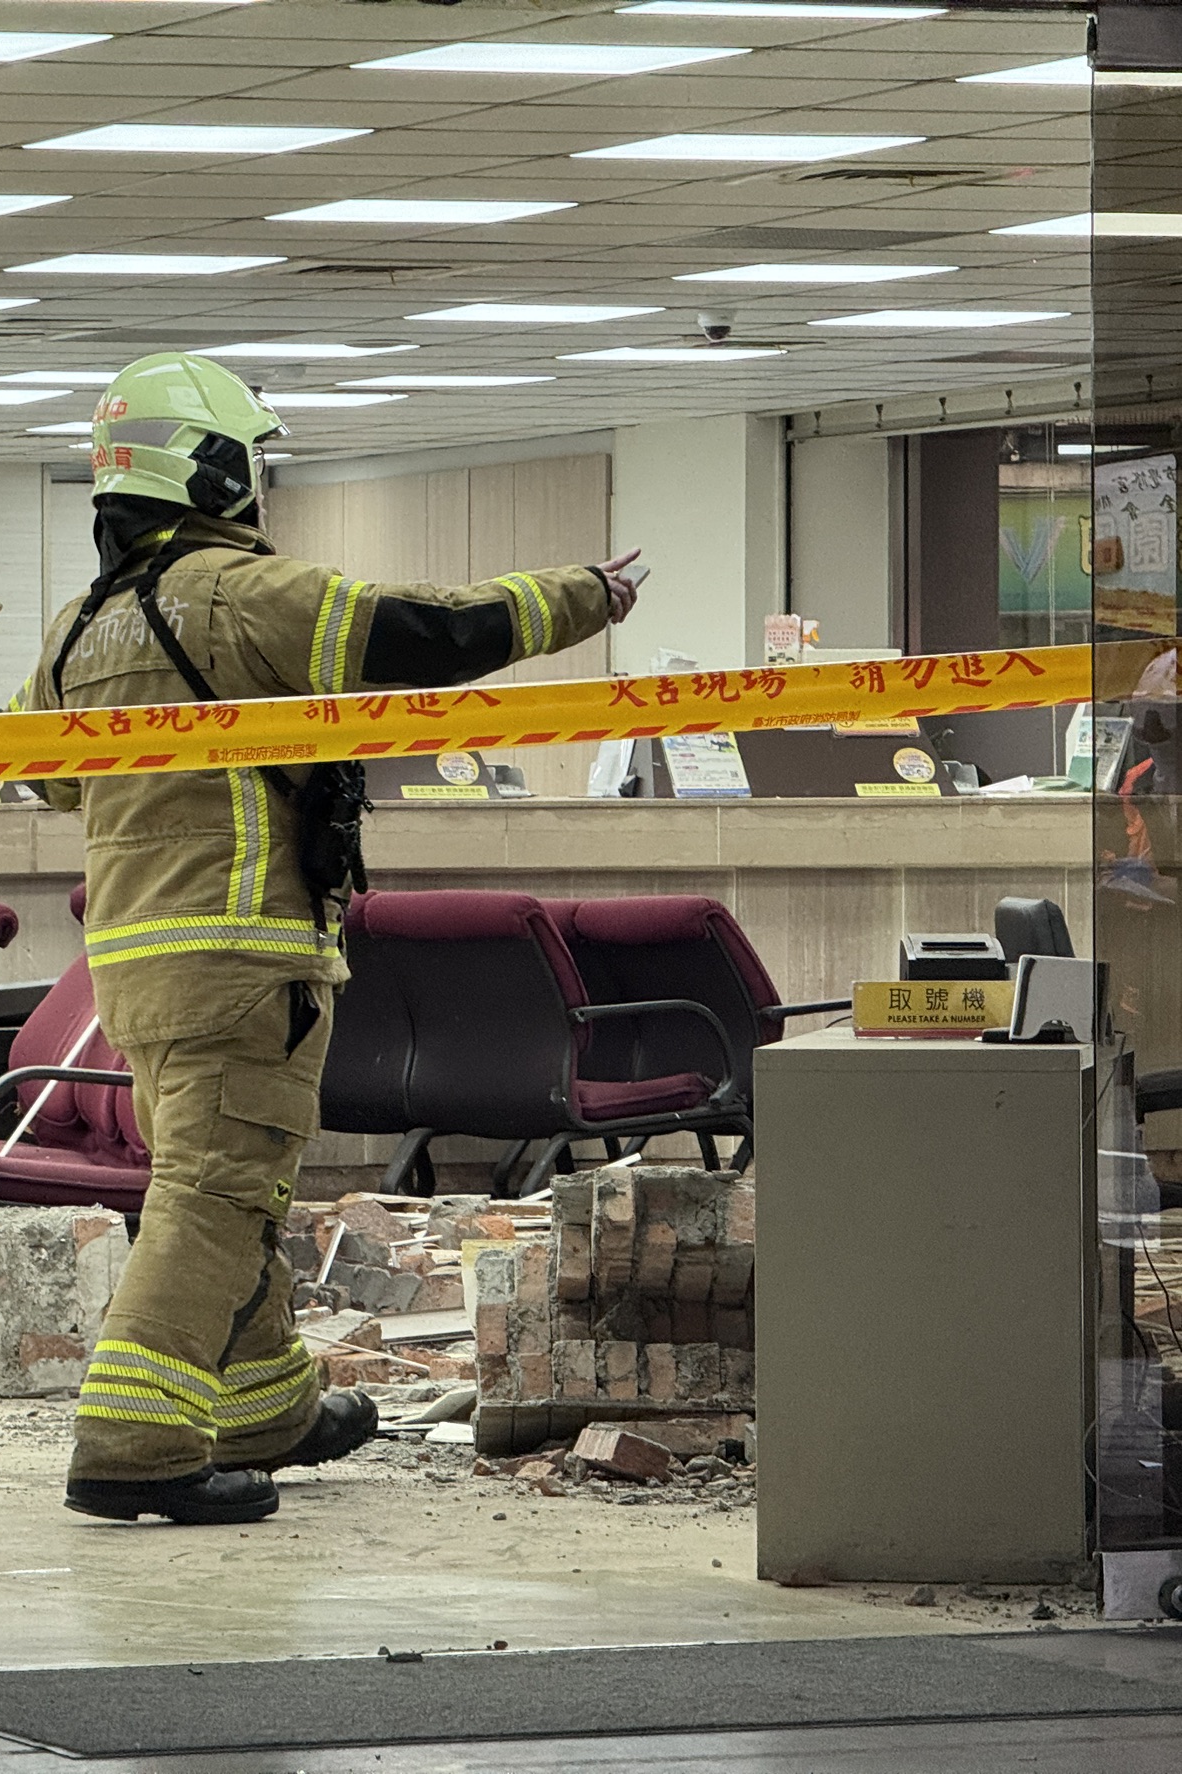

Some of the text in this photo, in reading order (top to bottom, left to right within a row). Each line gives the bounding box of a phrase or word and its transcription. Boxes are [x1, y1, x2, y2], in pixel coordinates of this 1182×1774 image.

[888, 987, 986, 1011] 取號機
[887, 1014, 986, 1023] PLEASE TAKE A NUMBER
